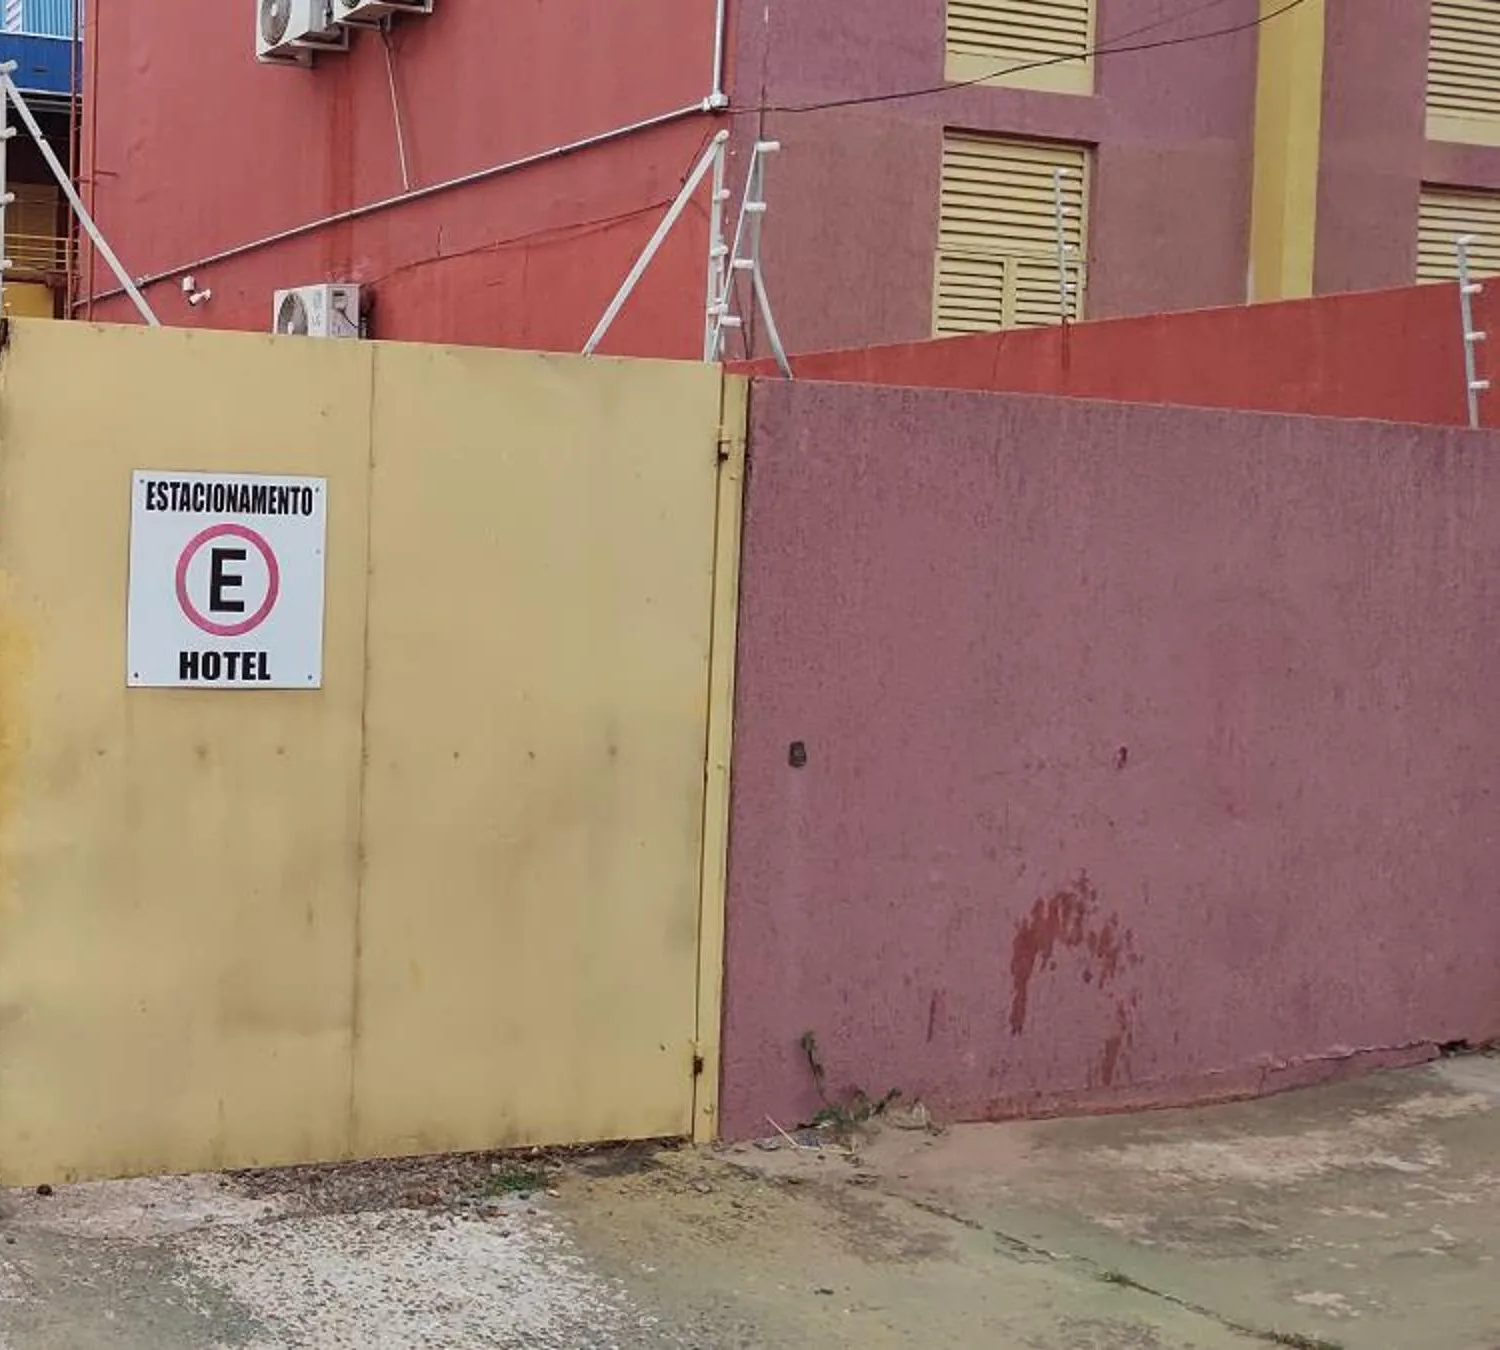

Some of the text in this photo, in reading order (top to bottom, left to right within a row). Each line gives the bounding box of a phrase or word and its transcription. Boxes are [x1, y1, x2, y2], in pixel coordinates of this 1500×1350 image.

[145, 481, 314, 516] ESTACIONAMENTO
[209, 547, 247, 613] E
[178, 651, 271, 681] HOTEL
